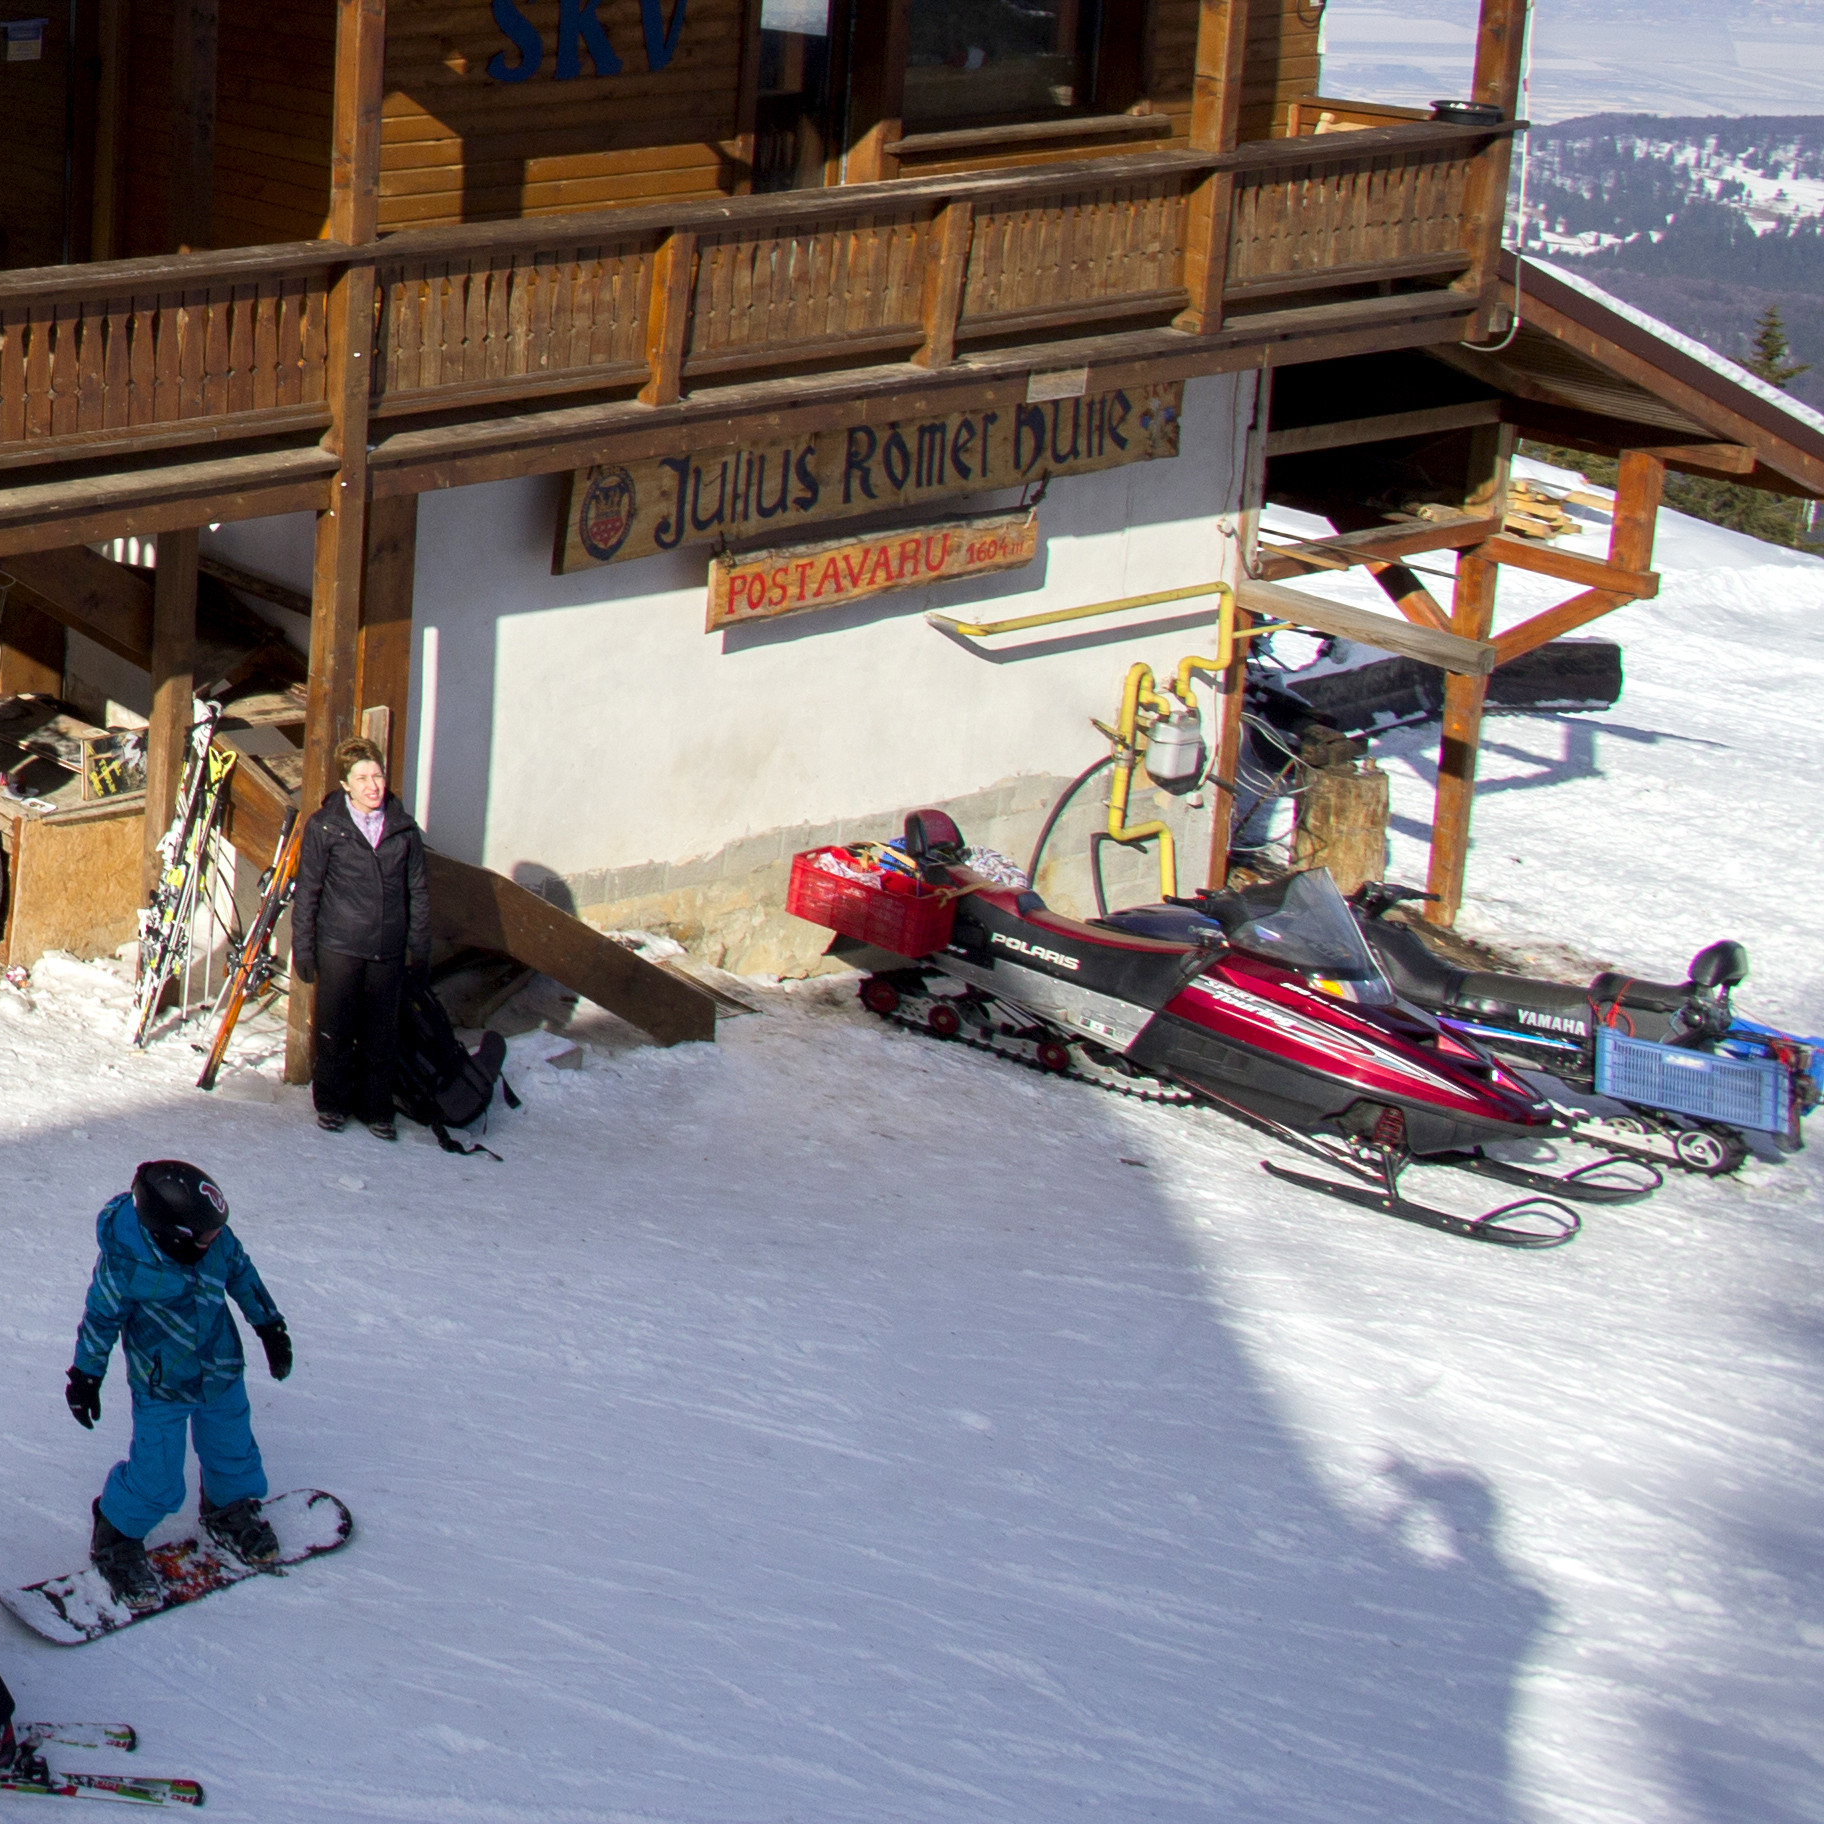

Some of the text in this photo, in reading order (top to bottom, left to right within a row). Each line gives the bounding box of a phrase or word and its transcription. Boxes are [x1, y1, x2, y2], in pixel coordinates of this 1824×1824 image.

[724, 532, 951, 615] POSTAVARU
[965, 535, 1008, 566] 1604
[990, 931, 1081, 971] POLARIS
[1204, 979, 1260, 1003] SPORT
[1211, 990, 1298, 1028] Touring
[1517, 1008, 1587, 1037] YAMAHA
